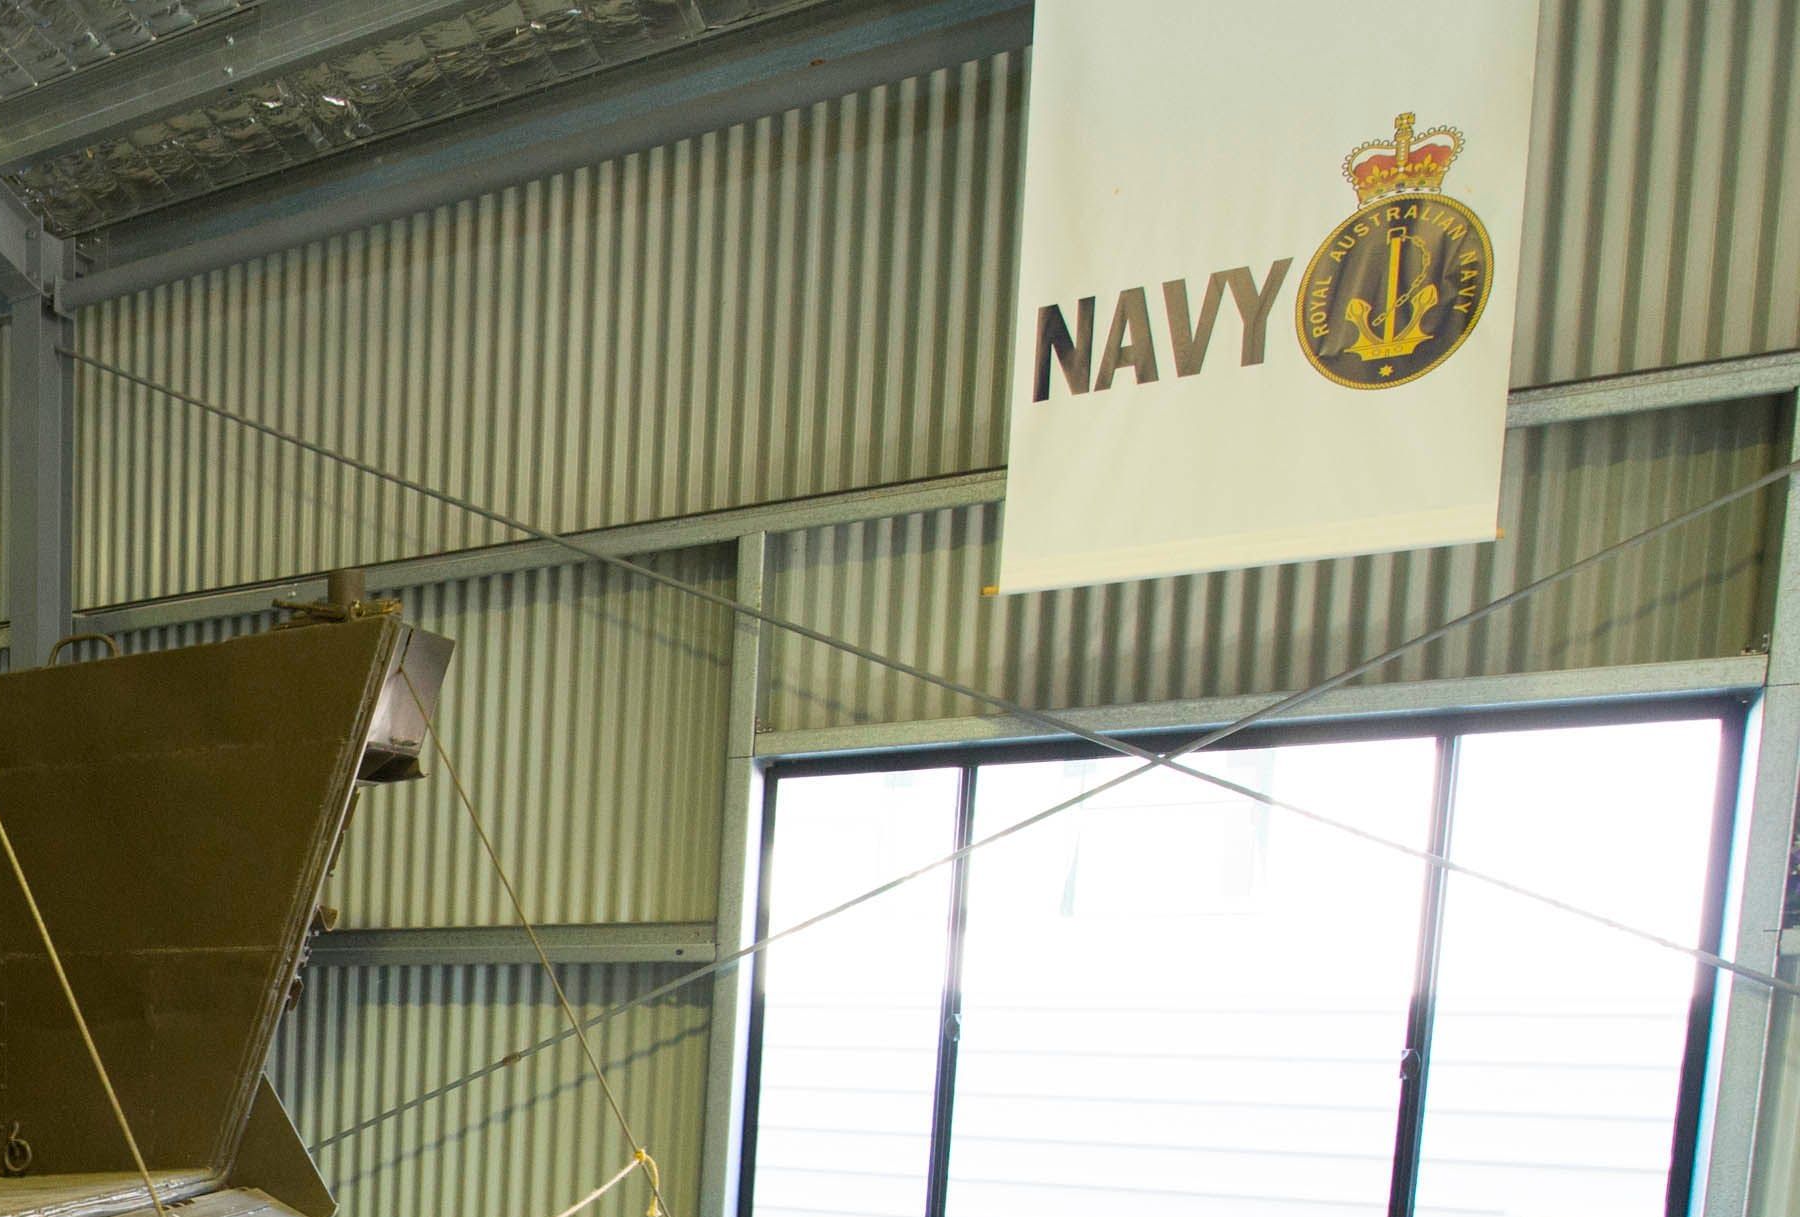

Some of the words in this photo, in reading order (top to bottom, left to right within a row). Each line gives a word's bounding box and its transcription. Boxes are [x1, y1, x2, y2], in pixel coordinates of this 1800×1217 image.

[1032, 257, 1294, 403] NAVY
[1310, 276, 1333, 338] ROYAL
[1329, 205, 1468, 263] AUSTRALIAN
[1453, 249, 1481, 314] NAVY
